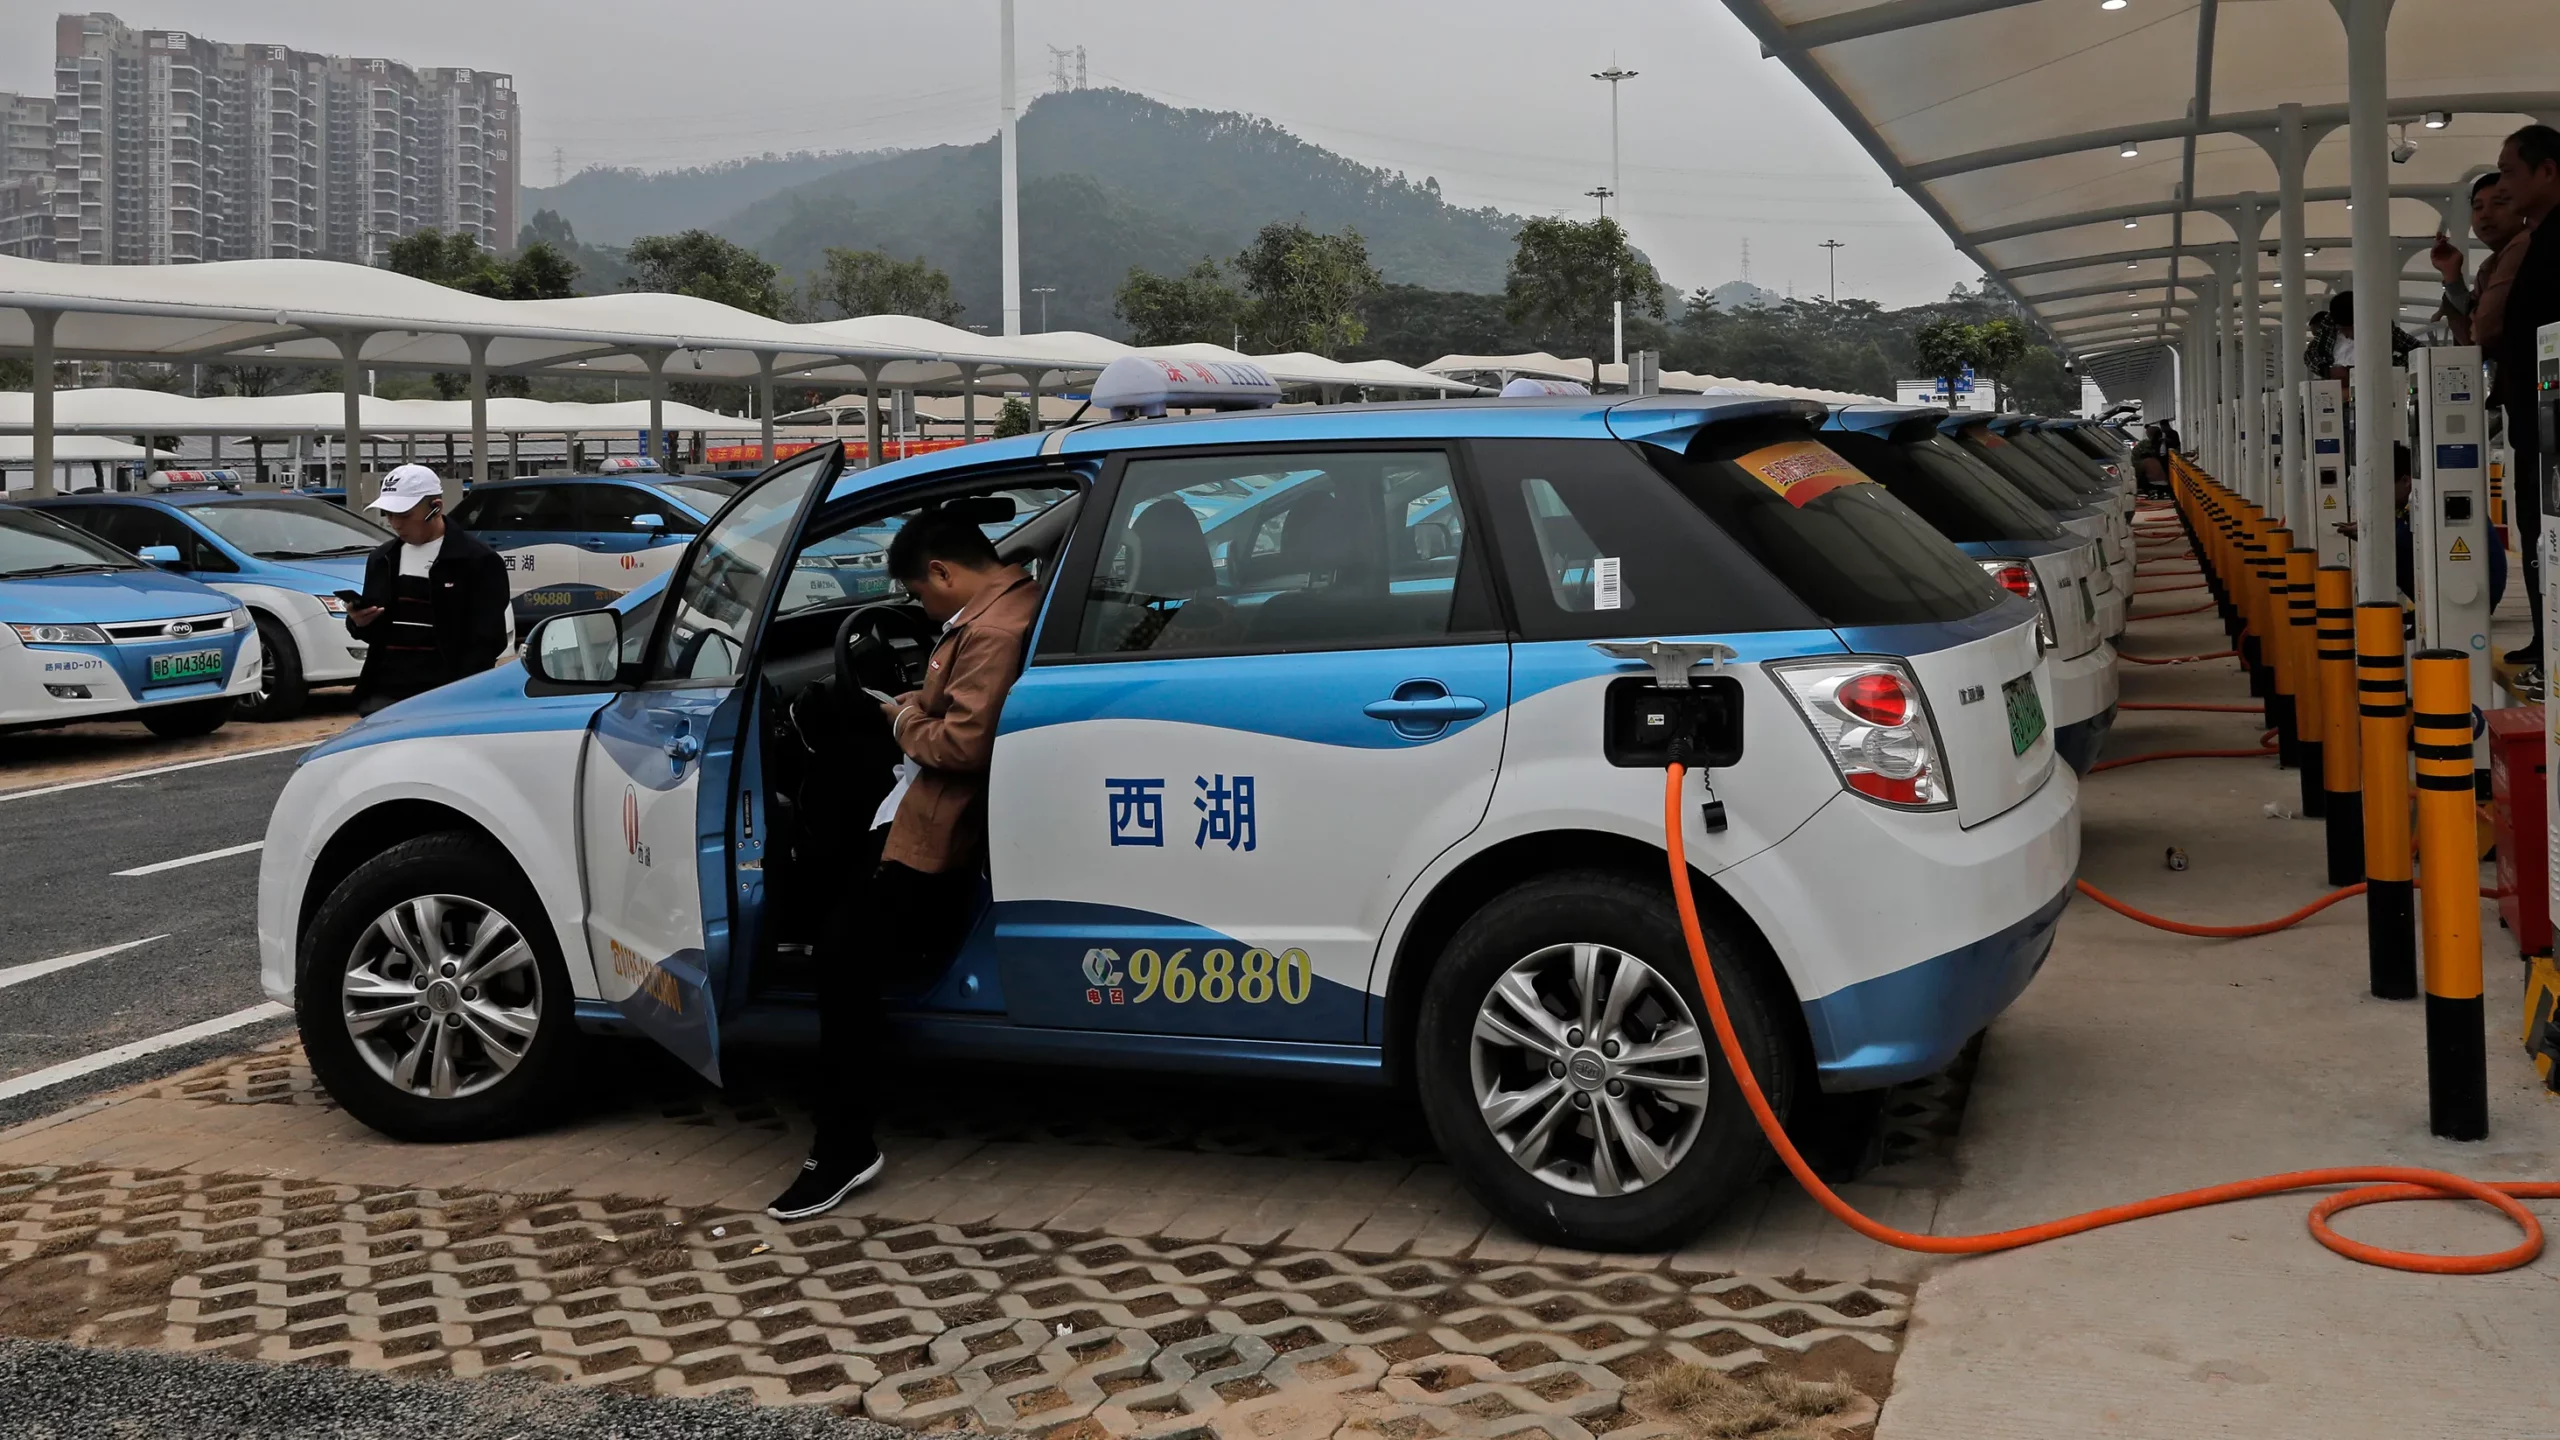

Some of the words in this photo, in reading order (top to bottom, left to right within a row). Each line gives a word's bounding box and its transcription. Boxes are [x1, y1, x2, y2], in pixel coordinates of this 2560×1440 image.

[1153, 359, 1219, 384] 深圳
[1209, 362, 1271, 386] TAXI
[503, 555, 535, 572] 西湖
[533, 592, 572, 605] 96880
[172, 624, 191, 633] BYD
[176, 653, 221, 674] D43846
[1105, 774, 1257, 852] 西湖
[1128, 947, 1312, 1004] 96880
[1086, 988, 1125, 1005] 电召
